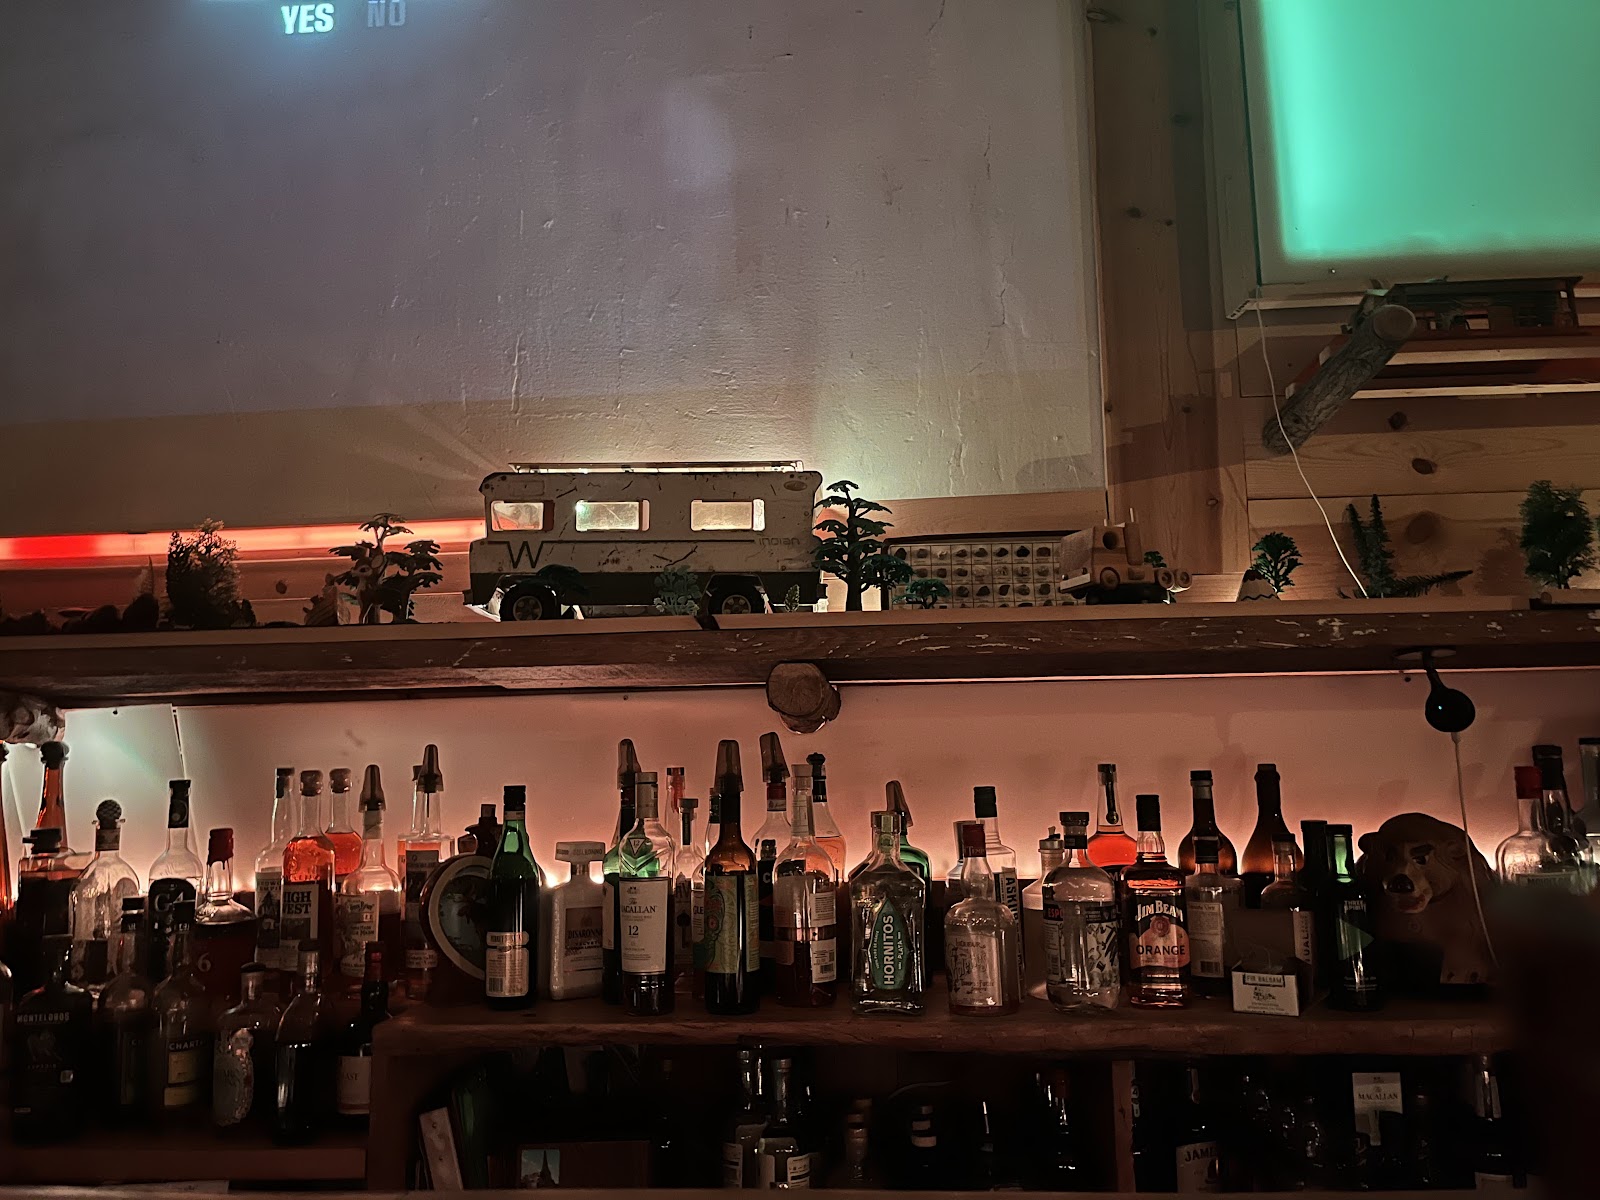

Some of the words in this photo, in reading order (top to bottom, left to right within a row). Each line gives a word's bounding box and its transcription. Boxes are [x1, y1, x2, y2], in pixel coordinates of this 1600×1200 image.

[281, 3, 334, 34] YES
[367, 0, 406, 27] NO
[1135, 903, 1155, 922] JIM
[1154, 899, 1184, 922] BEAM
[628, 925, 639, 936] 12
[882, 915, 895, 985] HORNITOS
[1136, 944, 1186, 956] ORANGE
